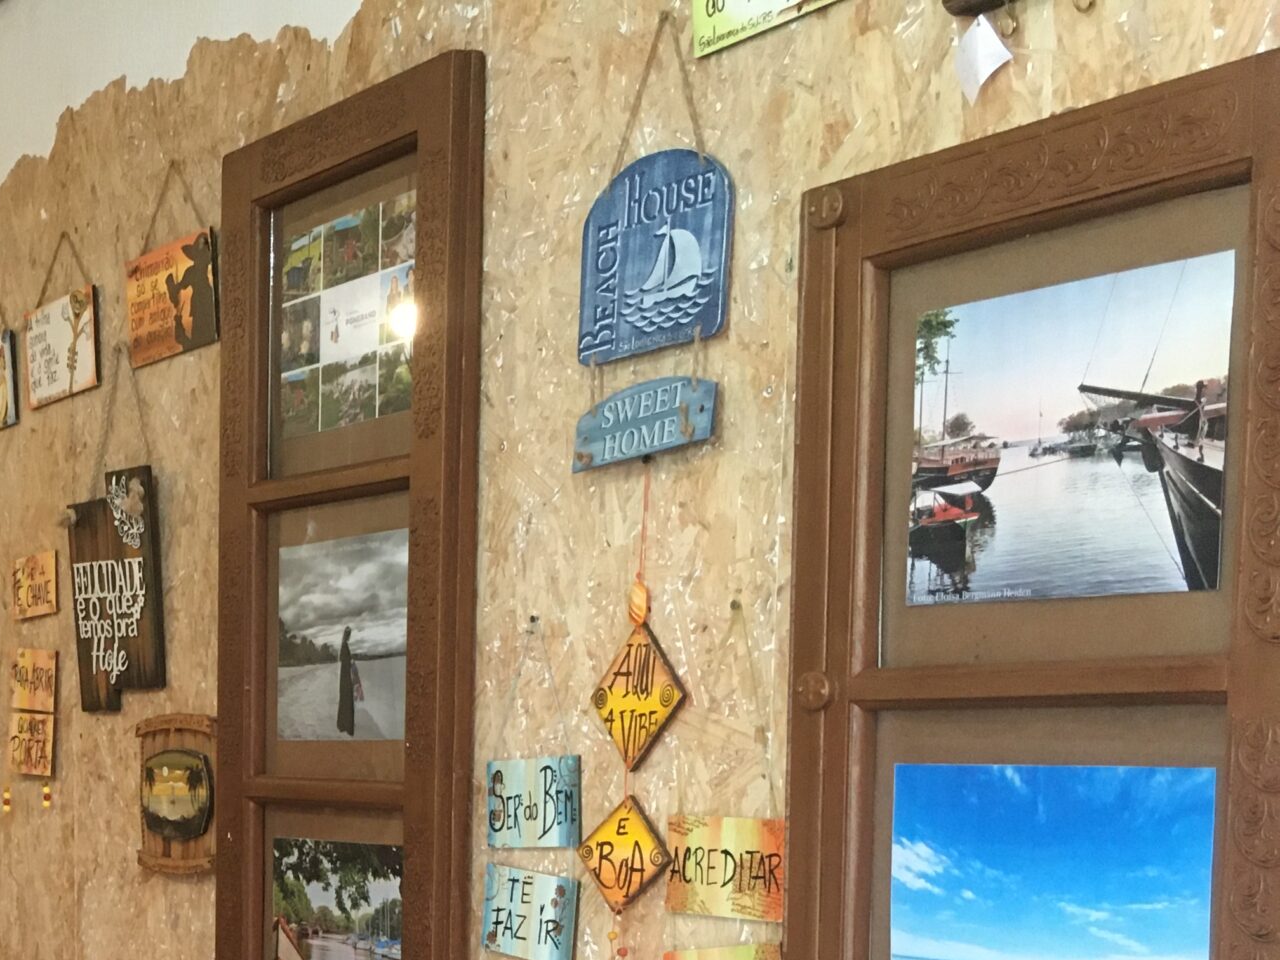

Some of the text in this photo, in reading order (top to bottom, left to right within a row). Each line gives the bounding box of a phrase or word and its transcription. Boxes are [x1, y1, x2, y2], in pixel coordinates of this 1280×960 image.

[580, 219, 620, 359] BEACH
[601, 380, 687, 429] SWEET
[601, 417, 677, 461] HOME
[73, 557, 146, 599] FELICIDADE
[79, 618, 138, 640] temos pra
[106, 594, 134, 624] que
[91, 636, 129, 684] Hoje
[608, 643, 657, 700] AQUI
[619, 708, 658, 756] VIBE
[523, 791, 538, 821] do
[670, 846, 783, 893] ACREDITAR
[492, 907, 527, 941] FAZ
